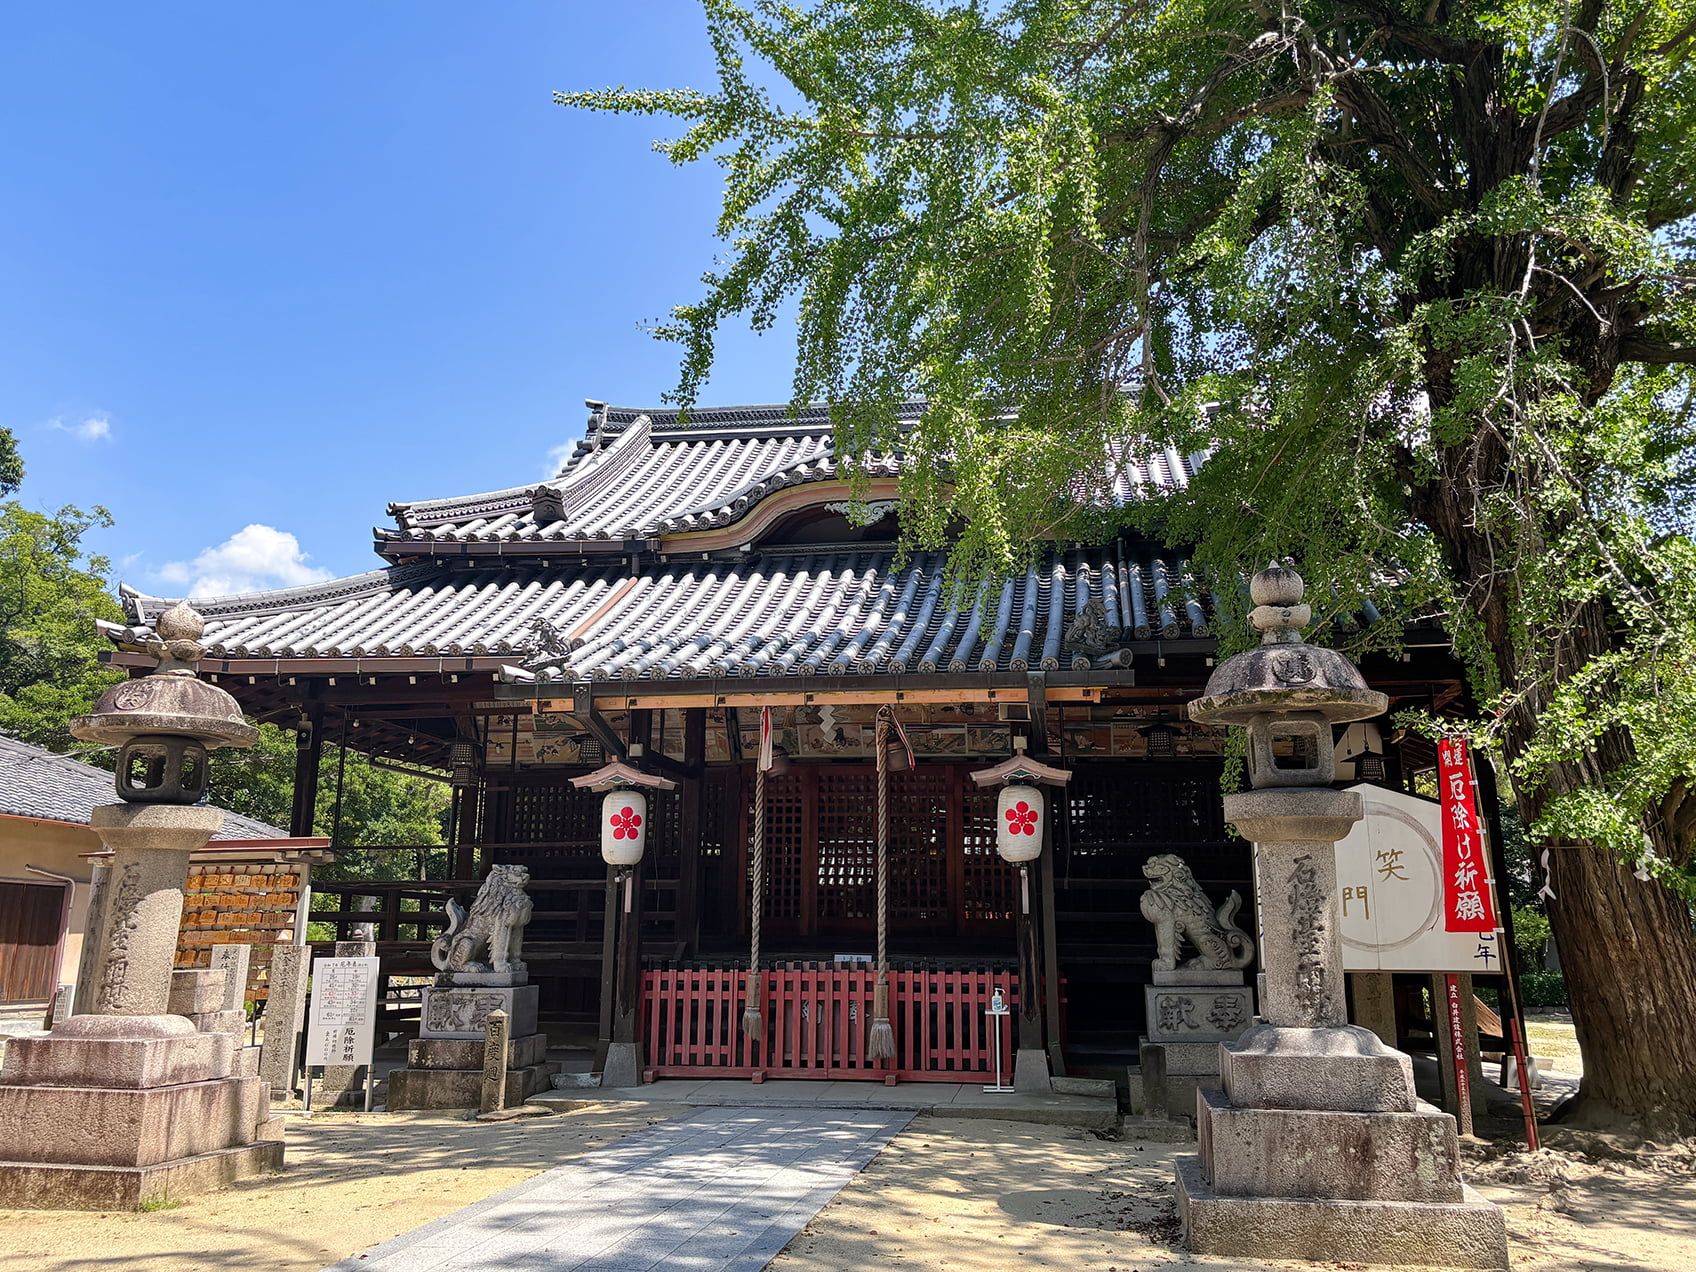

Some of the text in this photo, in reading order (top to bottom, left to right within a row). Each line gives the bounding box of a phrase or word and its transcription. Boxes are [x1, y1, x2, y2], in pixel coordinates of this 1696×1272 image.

[1448, 771, 1486, 921] 厄除け祈願
[1375, 848, 1410, 883] 笑
[1342, 886, 1370, 920] 門
[342, 1027, 356, 1062] 厄除祈願
